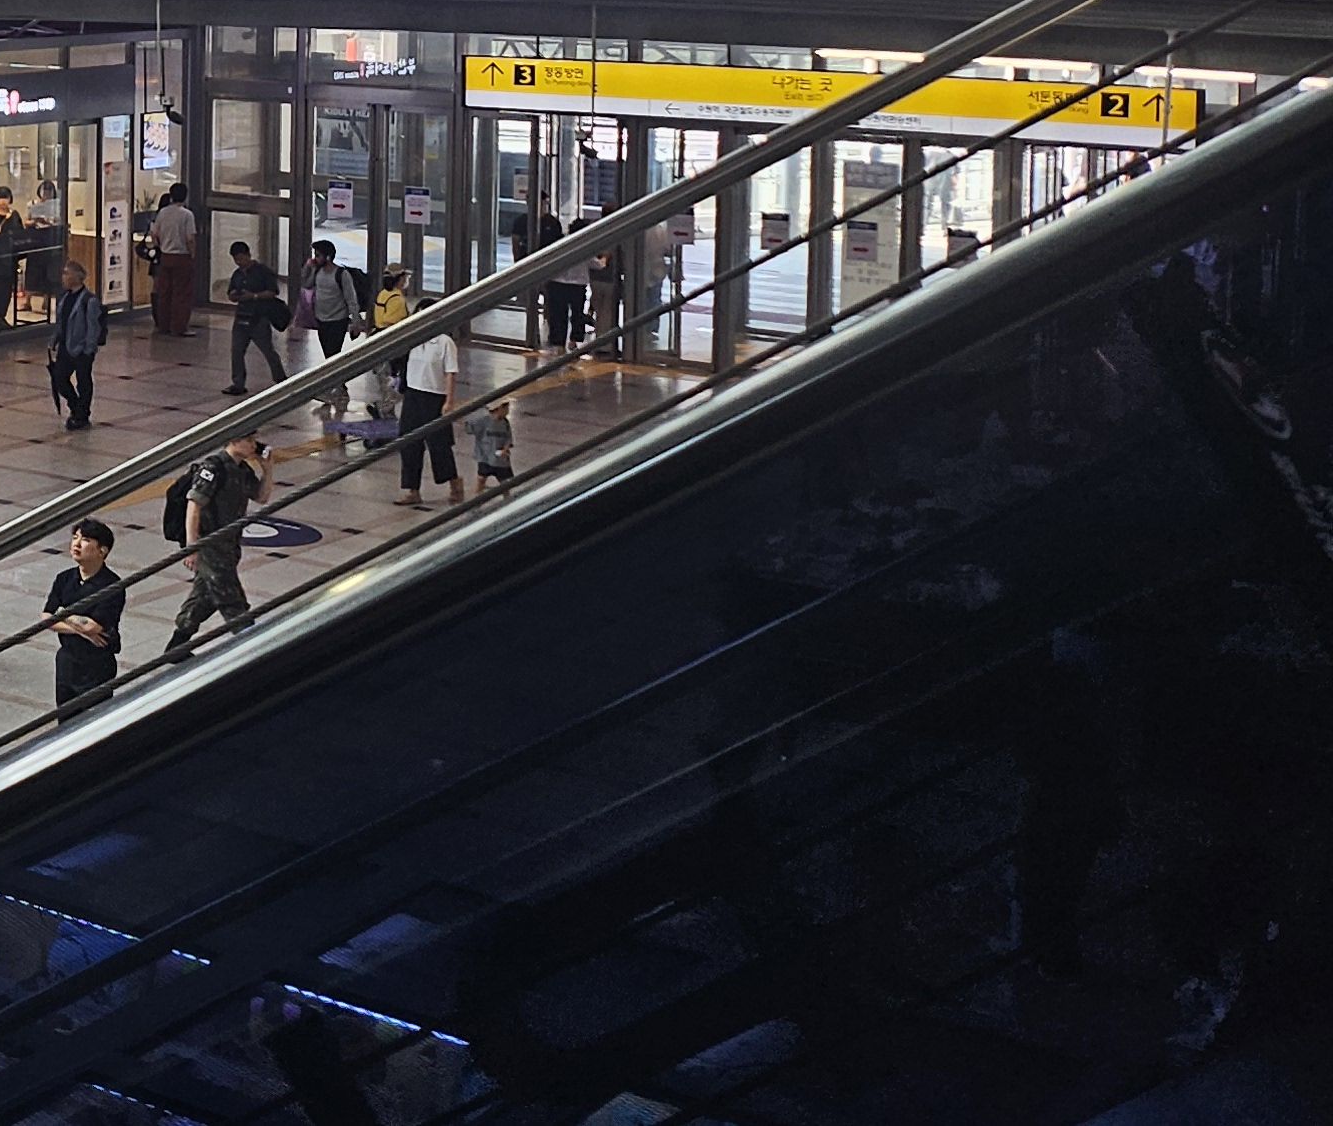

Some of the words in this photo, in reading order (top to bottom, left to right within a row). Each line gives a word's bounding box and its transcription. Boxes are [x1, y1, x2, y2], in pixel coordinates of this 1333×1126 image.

[519, 66, 532, 84] 3
[773, 76, 812, 90] 나가는
[819, 78, 833, 91] 곳
[784, 92, 804, 101] Exit
[1108, 95, 1123, 115] 2
